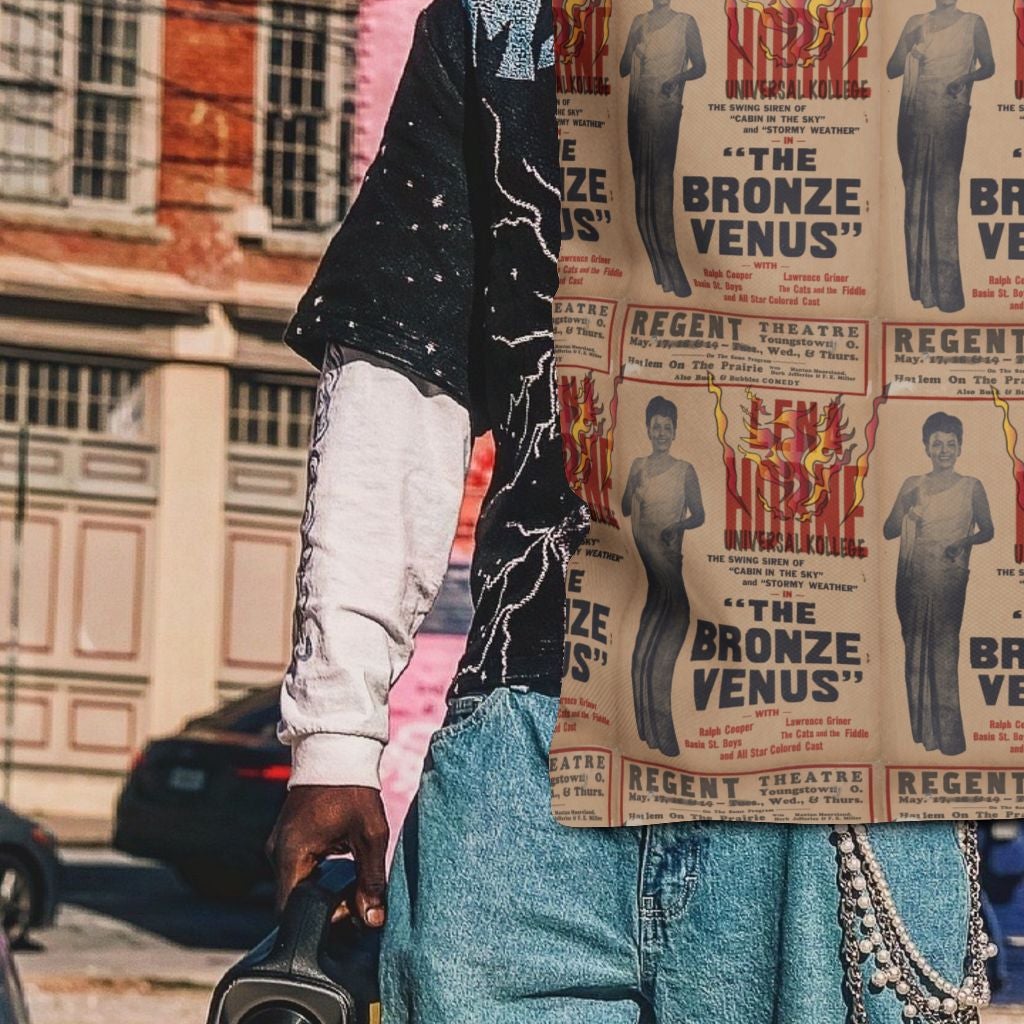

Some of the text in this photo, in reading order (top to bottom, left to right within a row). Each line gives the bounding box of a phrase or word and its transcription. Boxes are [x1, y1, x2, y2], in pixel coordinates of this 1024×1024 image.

[726, 79, 804, 99] UNIVERSAL
[998, 104, 1015, 112] THE
[762, 126, 803, 134] "STORMY
[811, 126, 859, 134] WEATHER"
[723, 148, 816, 171] "THE
[683, 176, 861, 215] BRONZE
[691, 218, 862, 258] VENUS"
[989, 276, 1011, 286] Ralph
[1010, 301, 1024, 310] and
[631, 311, 859, 340] REGENT THEATRE
[948, 375, 966, 384] On
[973, 375, 998, 384] The
[725, 530, 802, 554] UNIVERSAL
[707, 555, 726, 563] THE
[728, 556, 759, 564] SWING
[762, 557, 789, 565] SIREN
[729, 567, 762, 576] "CABIN
[780, 569, 798, 577] THE
[742, 579, 858, 592] and "STORMY WEATHER"
[724, 598, 816, 624] "THE
[690, 619, 861, 665] BRONZE
[693, 668, 863, 711] VENUS"
[755, 709, 779, 718] WITH
[628, 765, 863, 799] REGENT THEATRE
